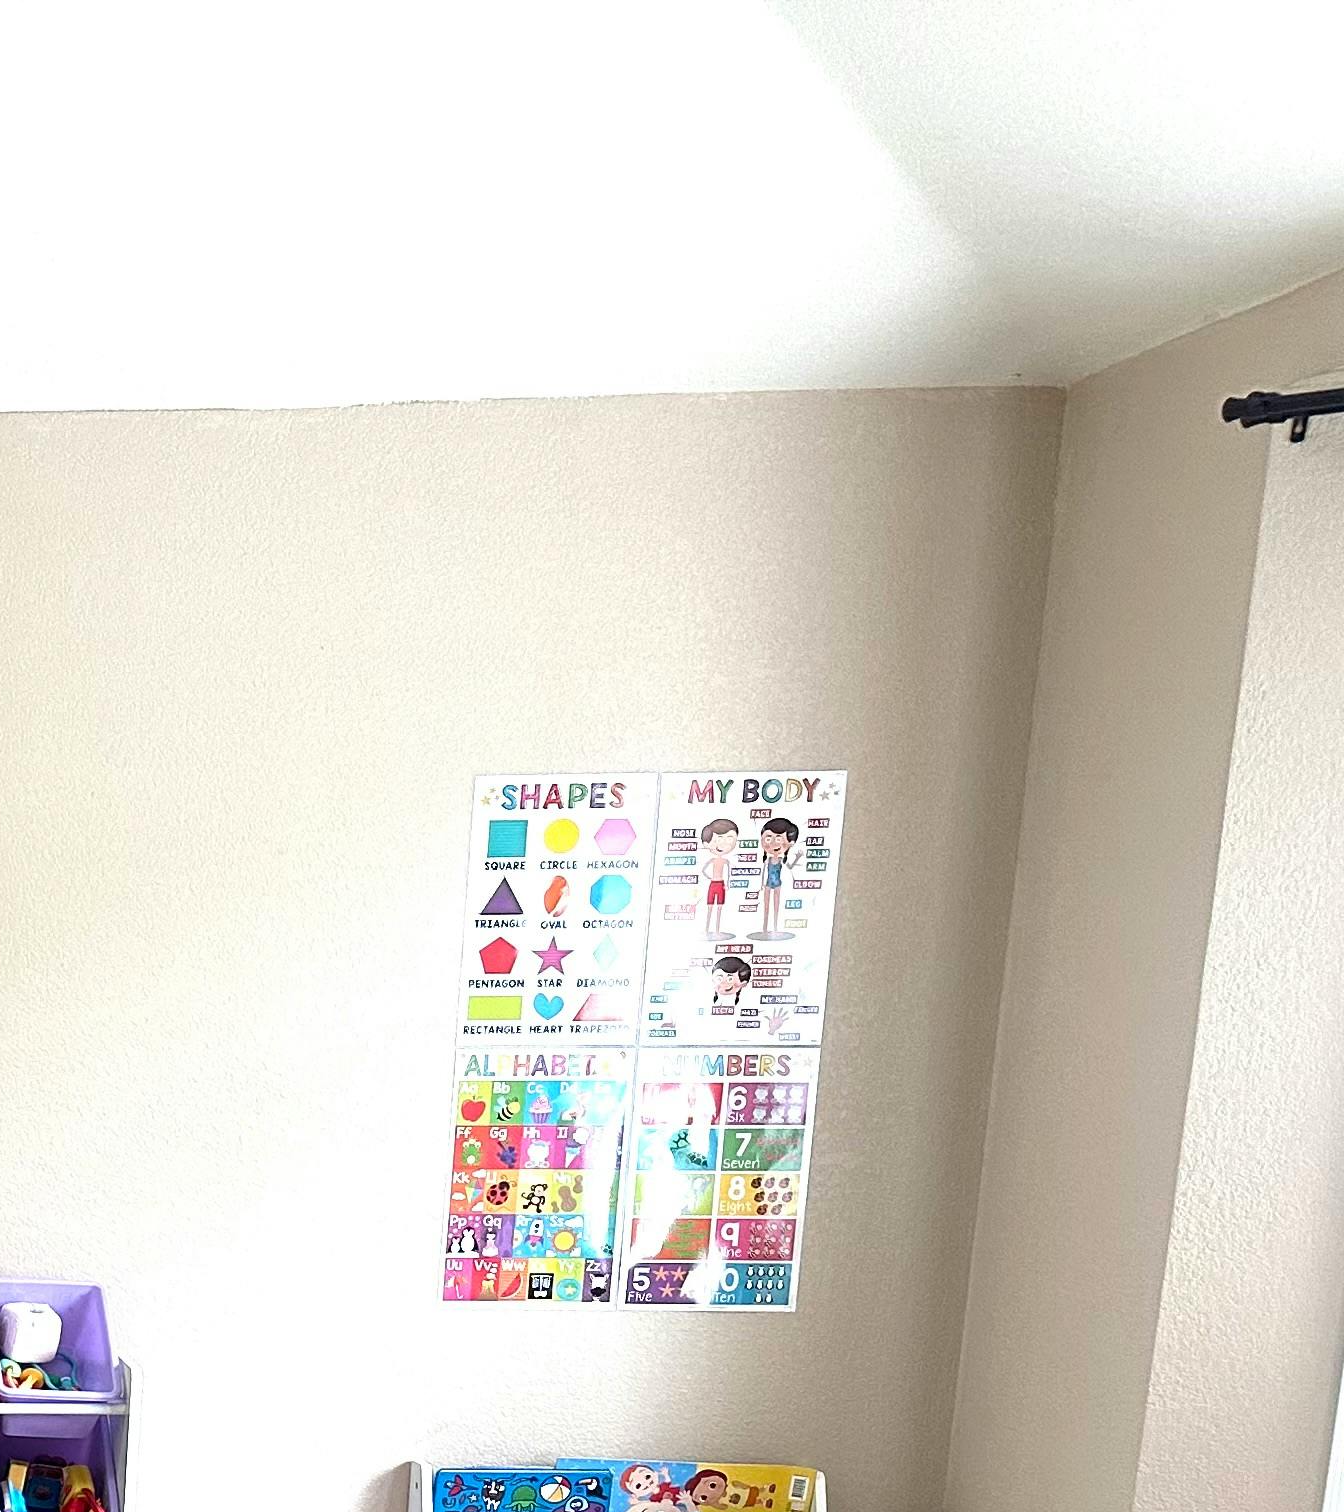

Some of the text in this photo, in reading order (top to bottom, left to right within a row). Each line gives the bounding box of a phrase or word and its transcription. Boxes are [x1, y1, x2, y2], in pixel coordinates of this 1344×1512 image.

[501, 783, 626, 810] SHAPES
[688, 778, 821, 804] MY BODY
[484, 861, 526, 871] SQUARE
[539, 860, 578, 870] CIRCLE
[586, 860, 639, 869] HEXAGON
[808, 863, 826, 871] ARM
[540, 920, 567, 929] OVAL
[582, 919, 634, 929] OCTAGON
[468, 979, 525, 988] PENTAGON
[537, 979, 563, 988] STAR
[576, 979, 630, 988] DIAMOND
[463, 1025, 523, 1035] RECTANGLE
[529, 1025, 564, 1034] HEART
[493, 1083, 510, 1093] Bb
[527, 1082, 543, 1094] Cc
[728, 1086, 748, 1111] 6
[727, 1112, 745, 1122] Six
[456, 1127, 472, 1139] Ff
[489, 1128, 508, 1141] Gg
[523, 1127, 541, 1138] Hh
[735, 1132, 752, 1157] 7
[723, 1158, 760, 1169] Seven
[453, 1172, 470, 1184] Kk
[728, 1176, 746, 1201] 8
[719, 1201, 753, 1211] Eight
[449, 1215, 468, 1227] Pp
[482, 1215, 502, 1229] Qq
[721, 1222, 740, 1246] 9
[446, 1260, 463, 1271] Uu
[501, 1259, 526, 1271] Ww
[586, 1260, 601, 1271] Zz
[632, 1267, 651, 1291] 5
[627, 1291, 653, 1302] Five
